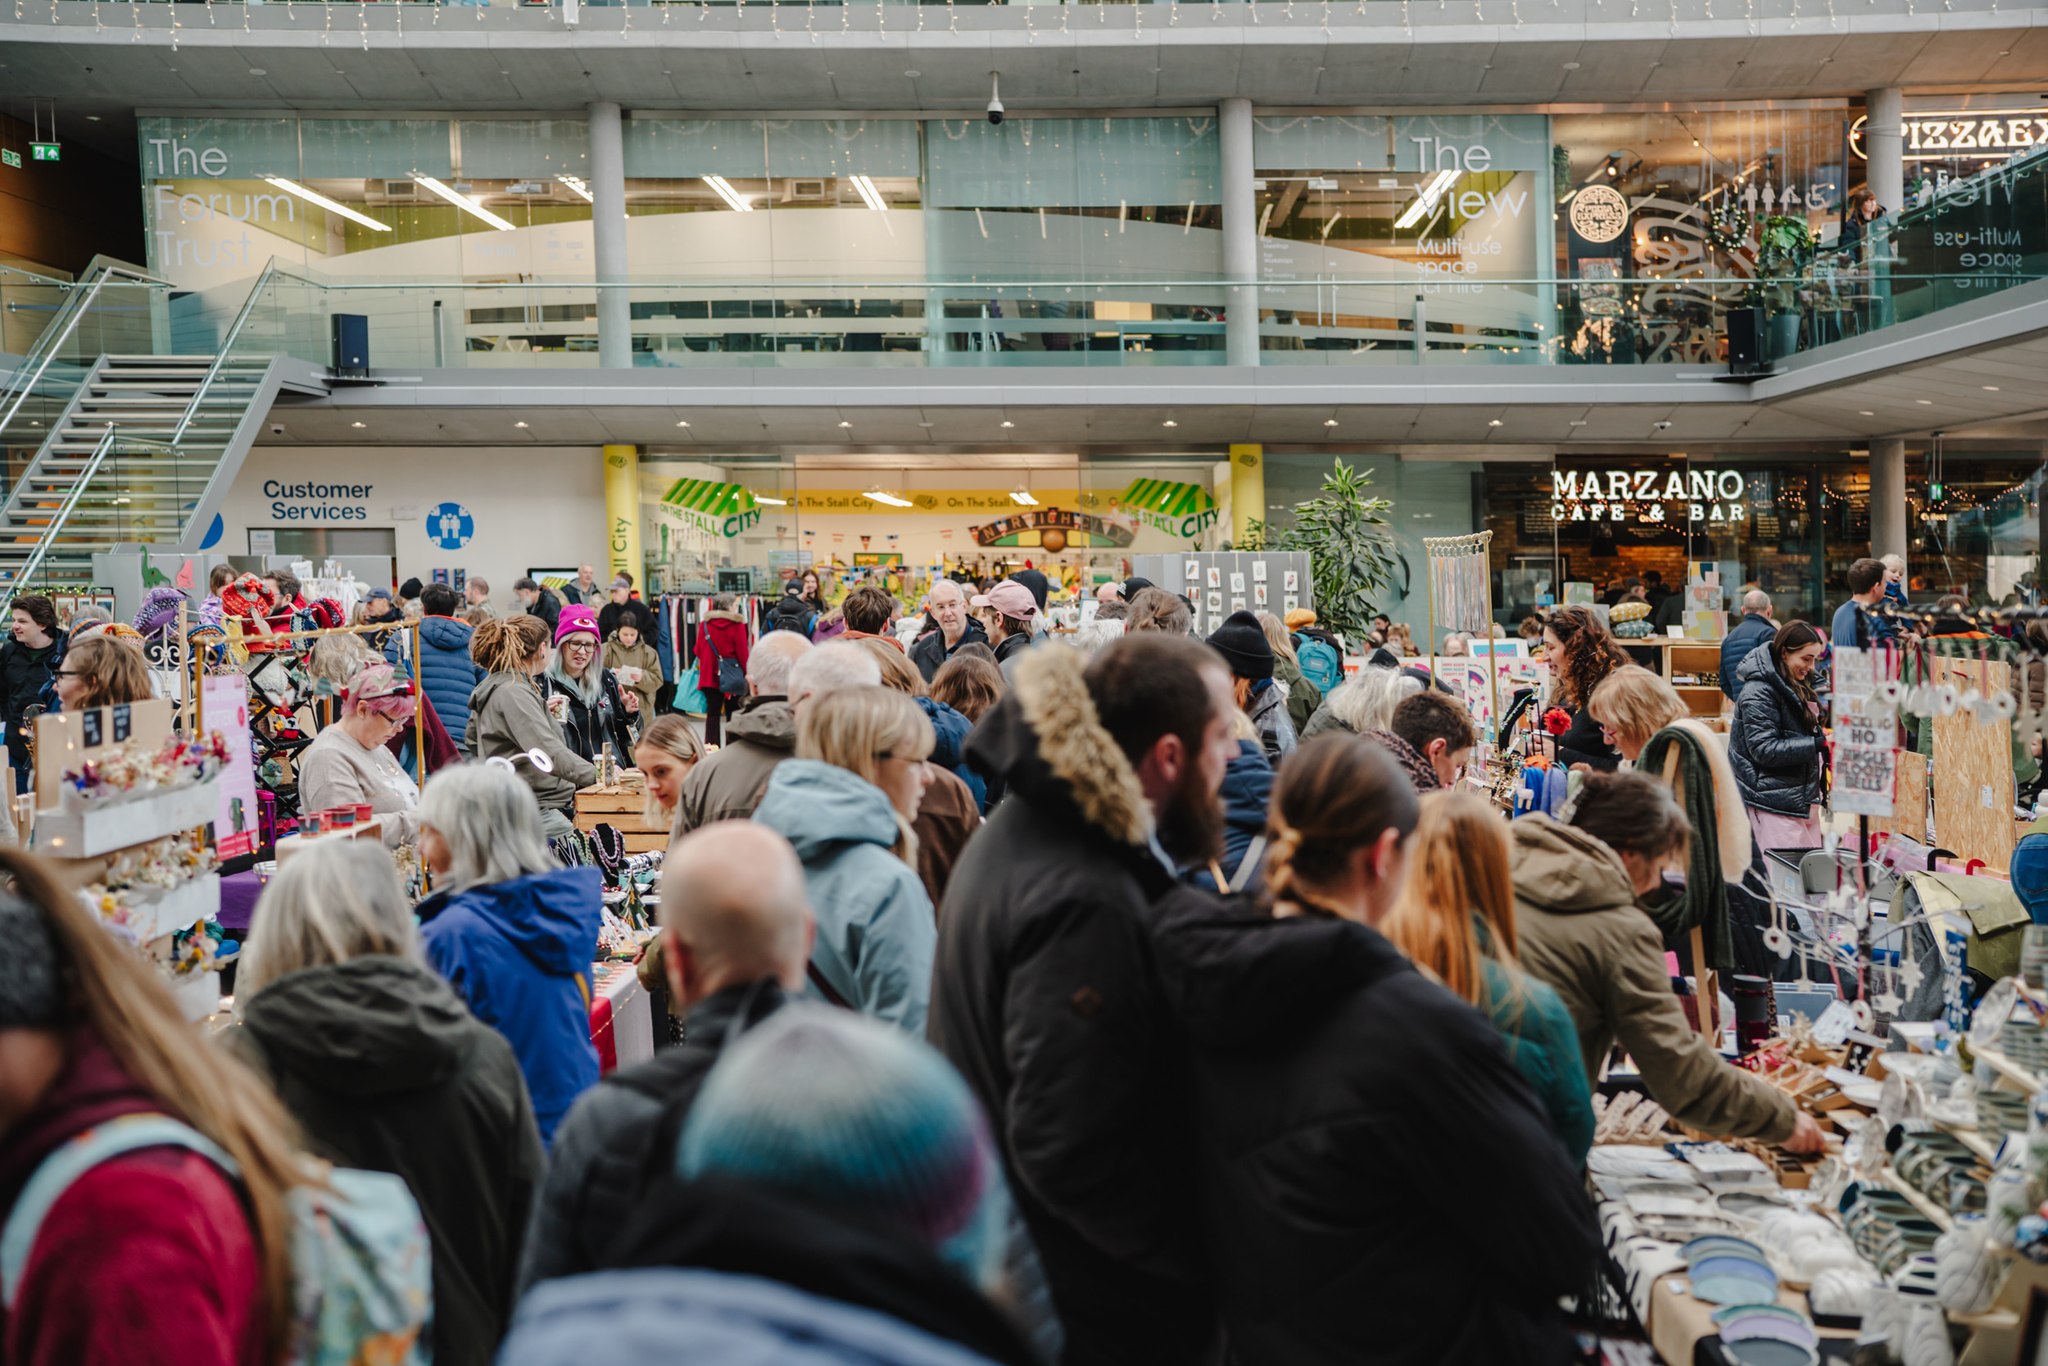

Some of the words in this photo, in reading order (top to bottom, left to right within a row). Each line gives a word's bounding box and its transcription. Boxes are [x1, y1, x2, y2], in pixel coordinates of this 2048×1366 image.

[149, 138, 228, 176] The
[1410, 136, 1492, 174] The
[154, 185, 295, 222] Forum
[1414, 183, 1528, 219] View
[156, 230, 252, 268] Trust
[1415, 237, 1503, 256] Multi-use
[1416, 260, 1479, 277] space
[263, 480, 373, 498] Customer
[1550, 470, 1744, 501] MARZANO
[271, 501, 367, 520] Services
[805, 496, 824, 508] The
[826, 496, 850, 508] Stall
[851, 496, 874, 511] City
[947, 497, 963, 508] On
[966, 497, 985, 508] The
[987, 497, 1010, 508] Stall
[659, 503, 670, 514] ON
[669, 505, 684, 521] THE
[684, 510, 721, 537] STALL
[723, 507, 762, 538] CITY
[1551, 504, 1626, 521] CAFE
[1649, 504, 1666, 521] &
[1689, 504, 1745, 521] BAR
[1142, 511, 1178, 537] STALL
[1181, 507, 1220, 538] CITY
[612, 517, 632, 552] City
[1851, 729, 1875, 744] HO
[1836, 761, 1892, 780] BLOODY
[1845, 776, 1882, 792] BELLS
